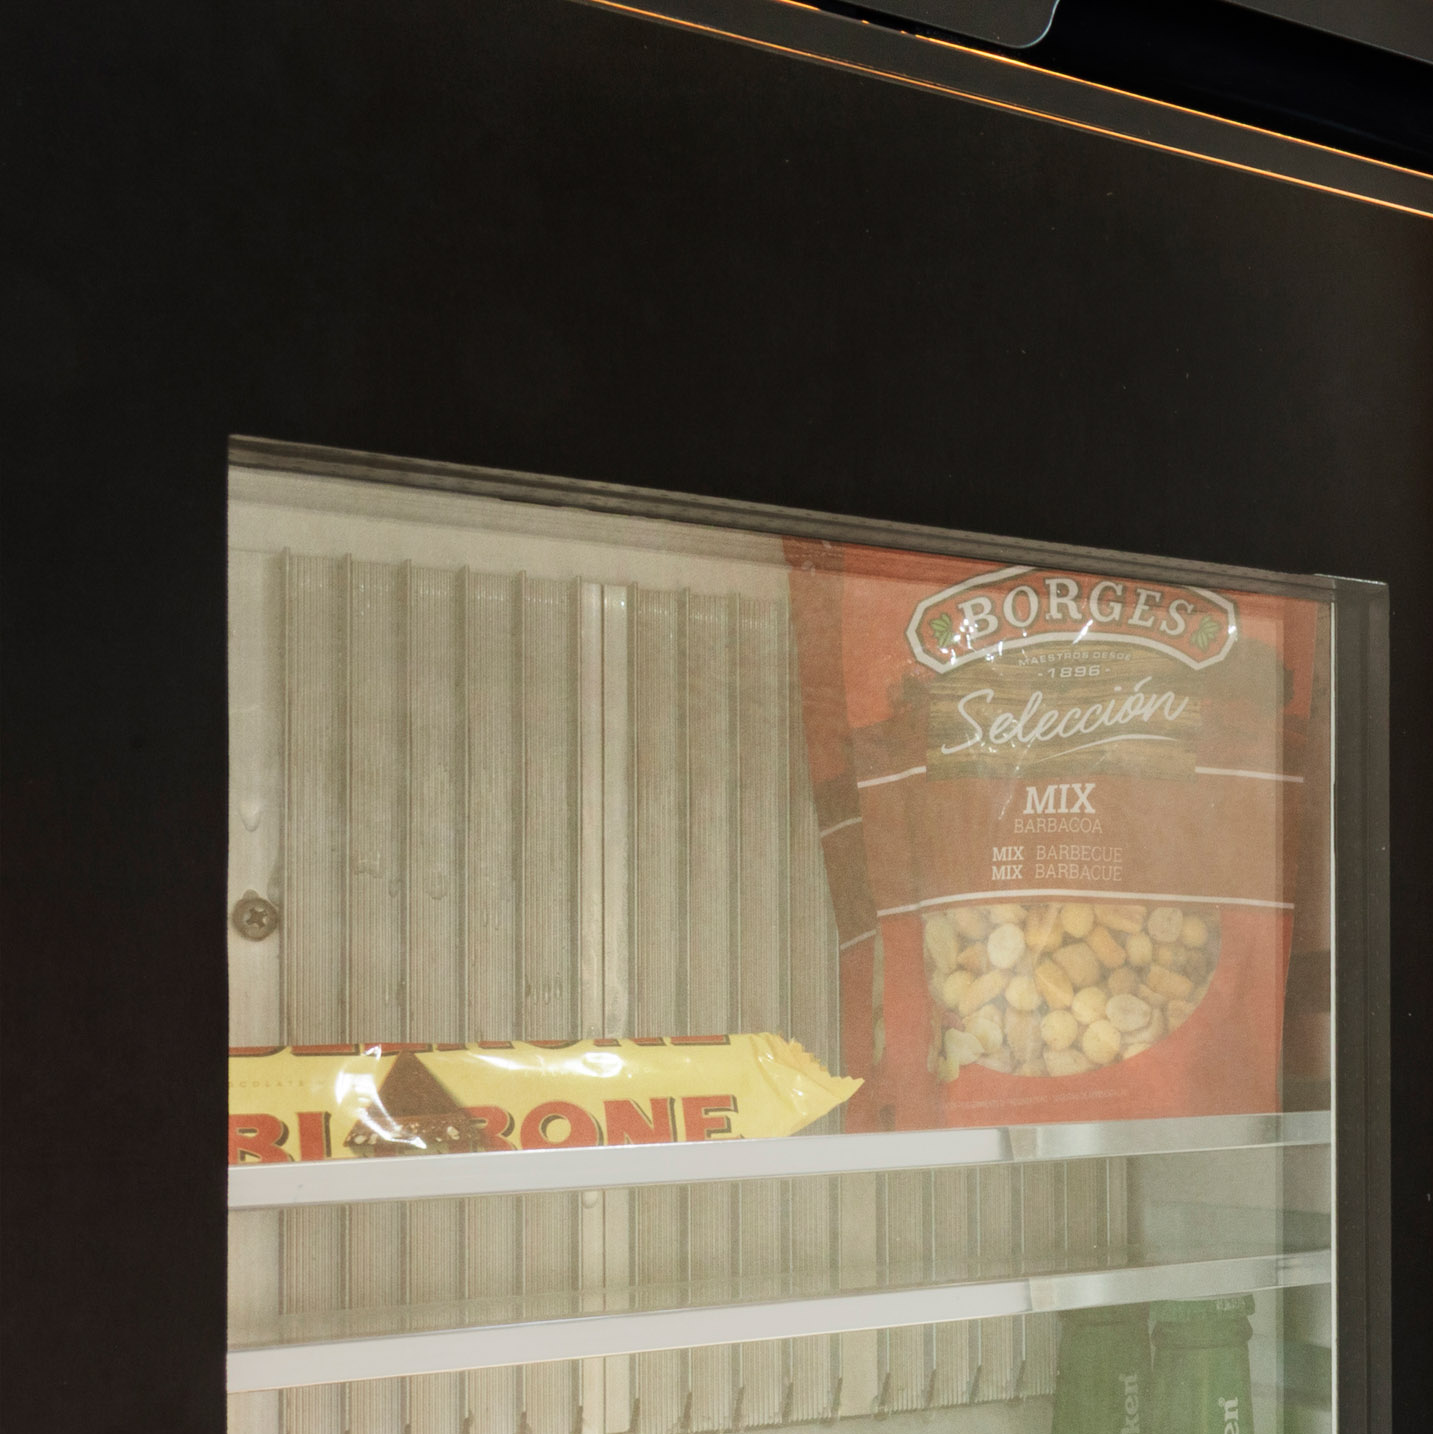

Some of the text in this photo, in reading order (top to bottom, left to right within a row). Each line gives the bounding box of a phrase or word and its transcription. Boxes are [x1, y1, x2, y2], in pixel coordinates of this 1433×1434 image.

[958, 578, 1194, 640] BORGES
[1018, 651, 1133, 666] MAESTROS DESDE
[941, 676, 1189, 754] Selección
[1023, 783, 1096, 814] MIX
[1014, 817, 1103, 833] BARBACOA
[992, 845, 1123, 863] MIX BARBECUE
[992, 864, 1023, 880] MIX
